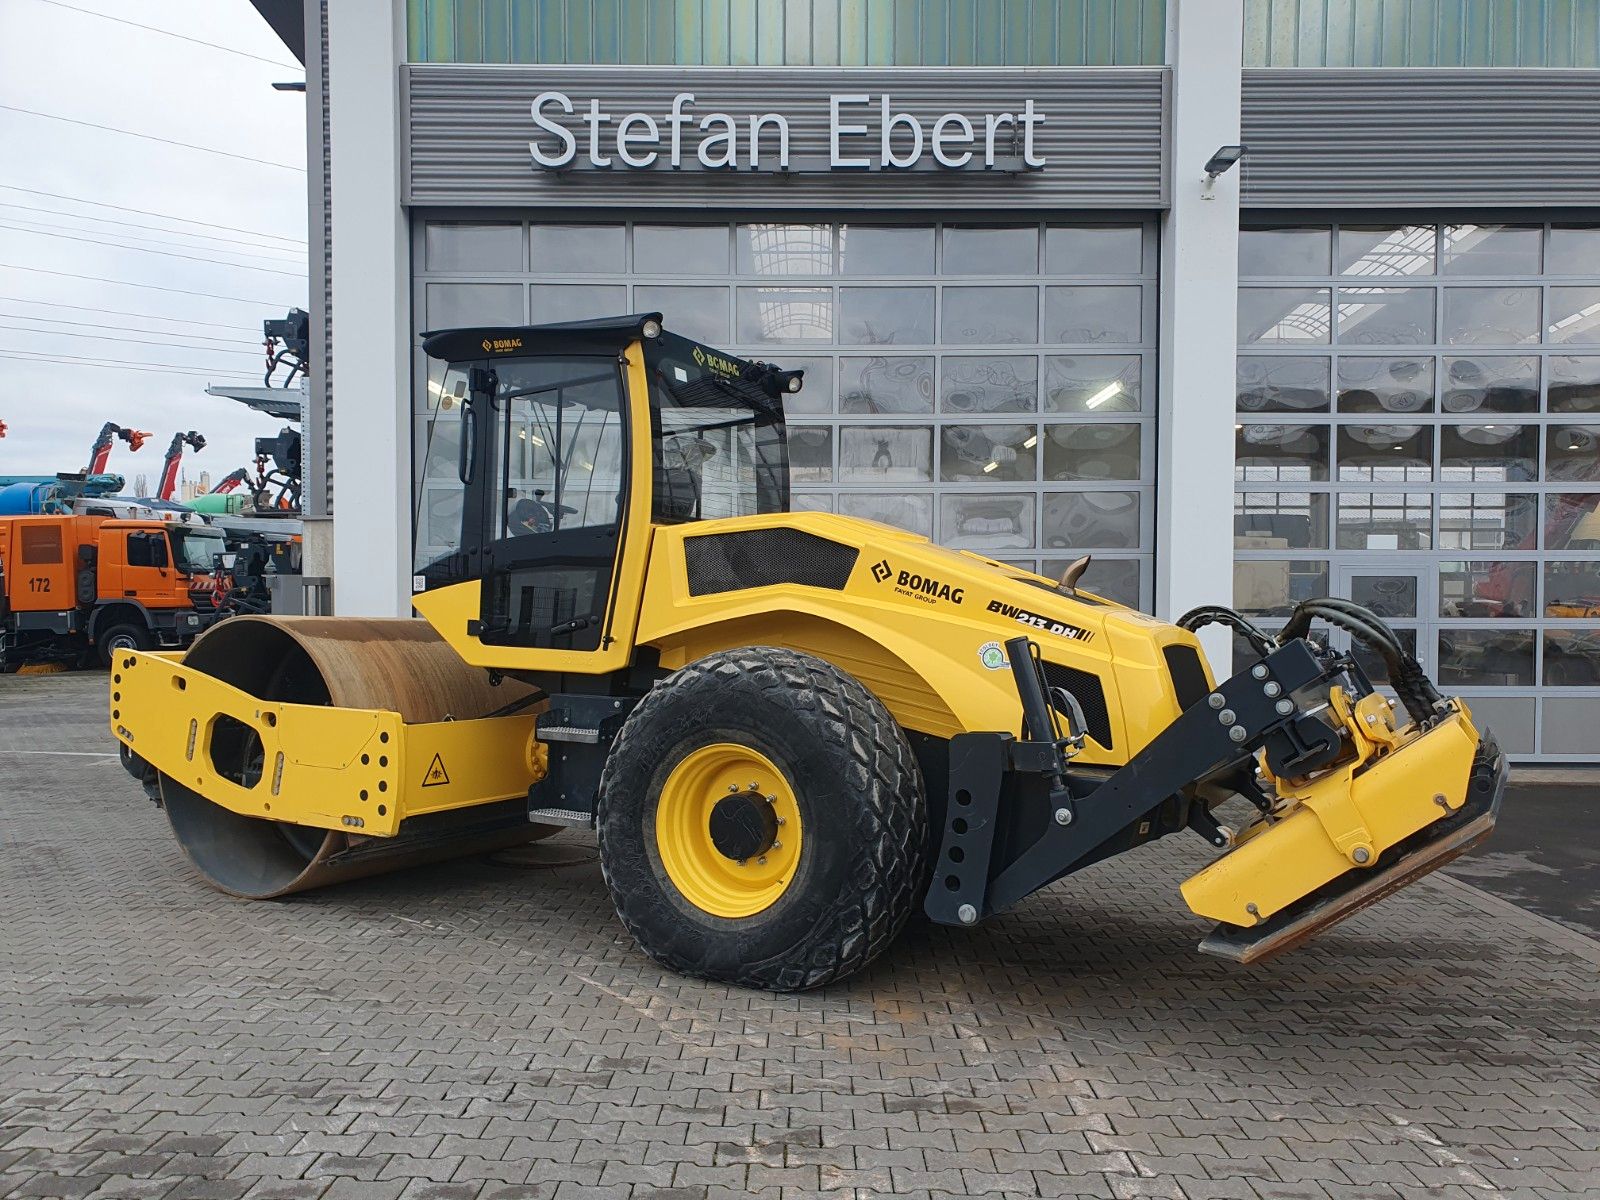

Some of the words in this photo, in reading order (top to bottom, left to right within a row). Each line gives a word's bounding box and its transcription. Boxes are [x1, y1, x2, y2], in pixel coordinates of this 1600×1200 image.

[529, 91, 790, 168] Stefan
[830, 93, 1047, 168] Ebert
[493, 338, 522, 349] BOMAG
[28, 577, 51, 593] 172
[896, 569, 965, 605] BOMAG
[894, 586, 913, 598] FAYAT
[914, 593, 937, 605] GROUP
[1048, 622, 1078, 640] DH
